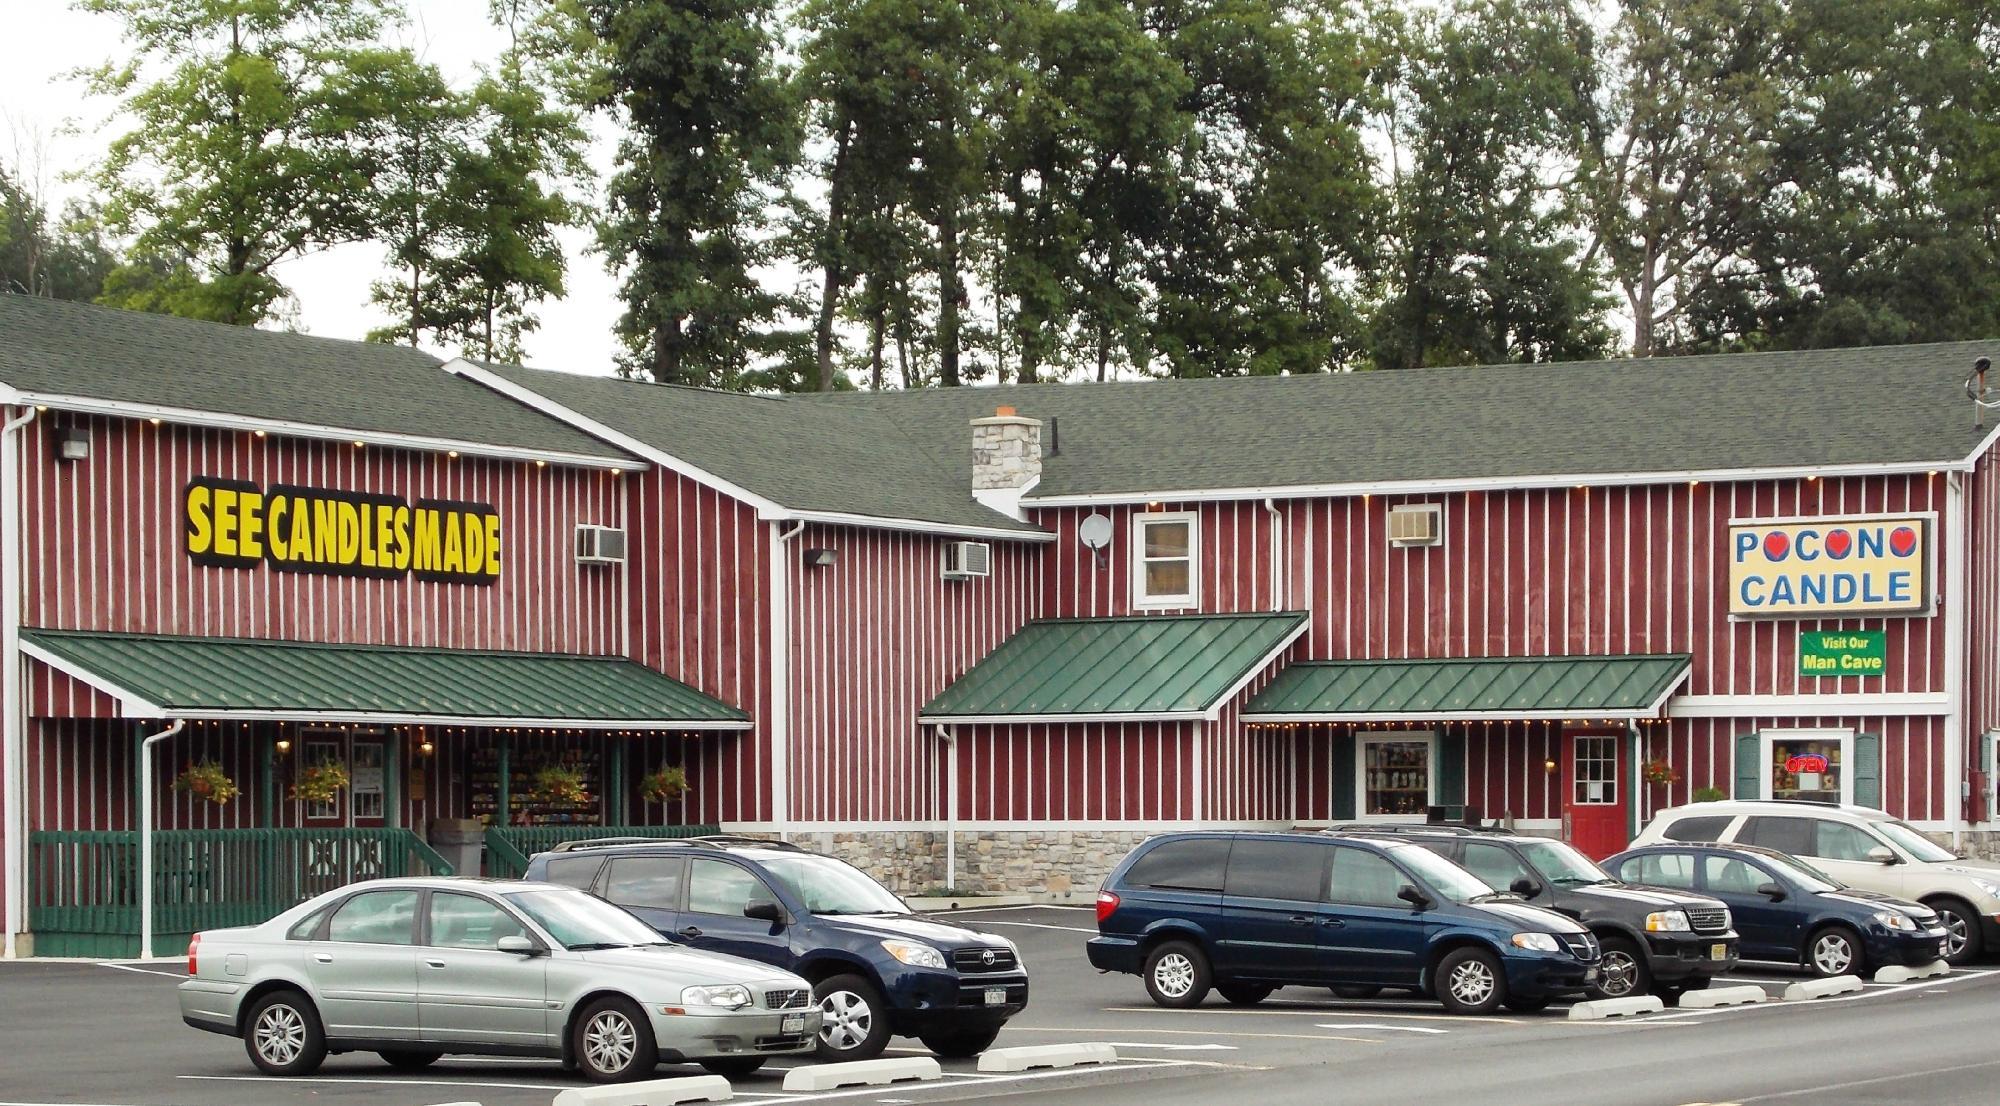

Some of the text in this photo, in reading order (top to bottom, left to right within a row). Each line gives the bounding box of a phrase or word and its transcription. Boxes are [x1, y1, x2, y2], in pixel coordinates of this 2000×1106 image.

[187, 485, 500, 575] SEE CANDLES MADE
[1736, 526, 1917, 563] POCONO
[1740, 571, 1911, 606] CANDLE
[1822, 637, 1869, 649] Visit Our
[1803, 654, 1882, 670] Man Cave
[1786, 757, 1827, 773] OPEN
